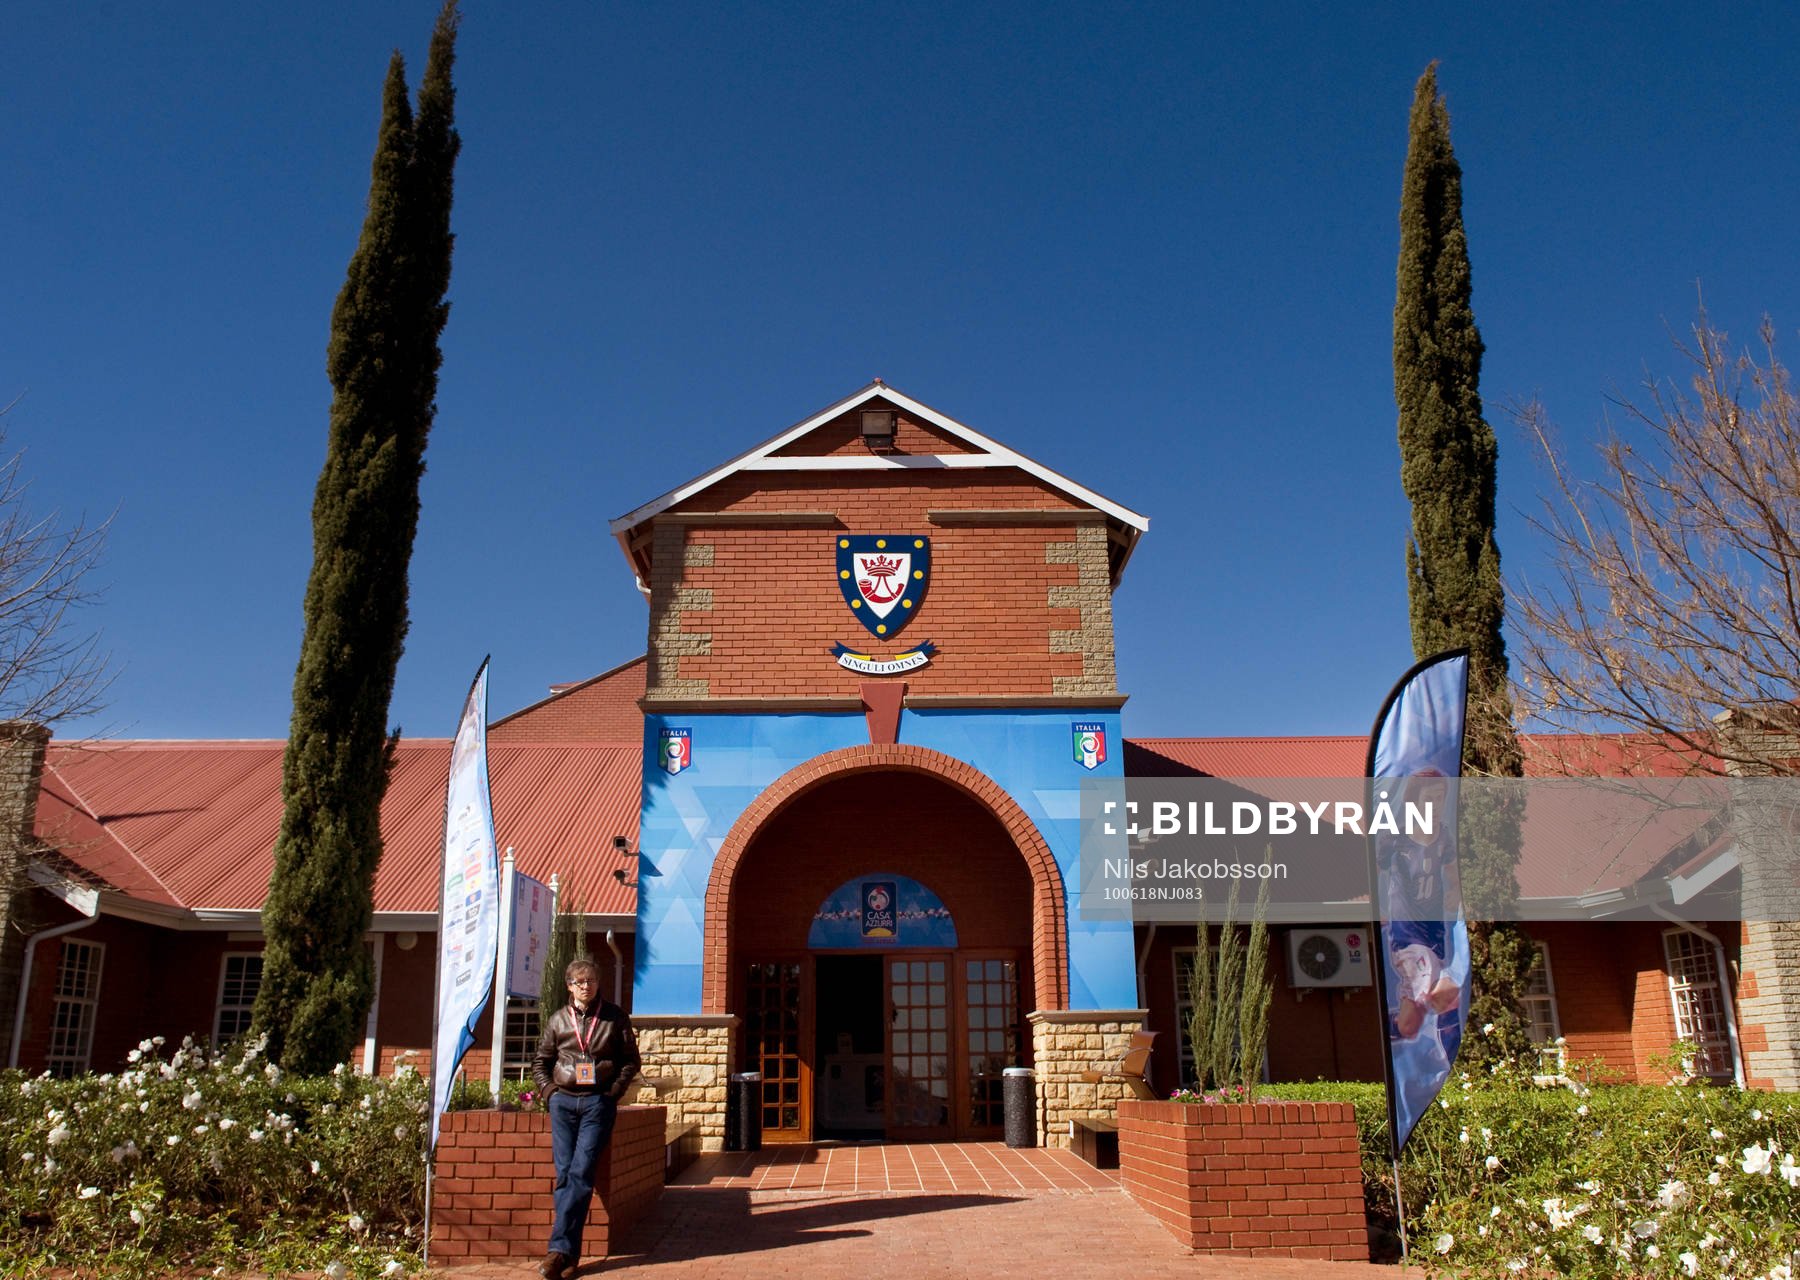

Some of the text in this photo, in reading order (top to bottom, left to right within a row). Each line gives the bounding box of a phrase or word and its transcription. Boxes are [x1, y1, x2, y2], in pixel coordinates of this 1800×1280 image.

[843, 656, 924, 672] SINGULI OMNES
[867, 911, 890, 919] CASA
